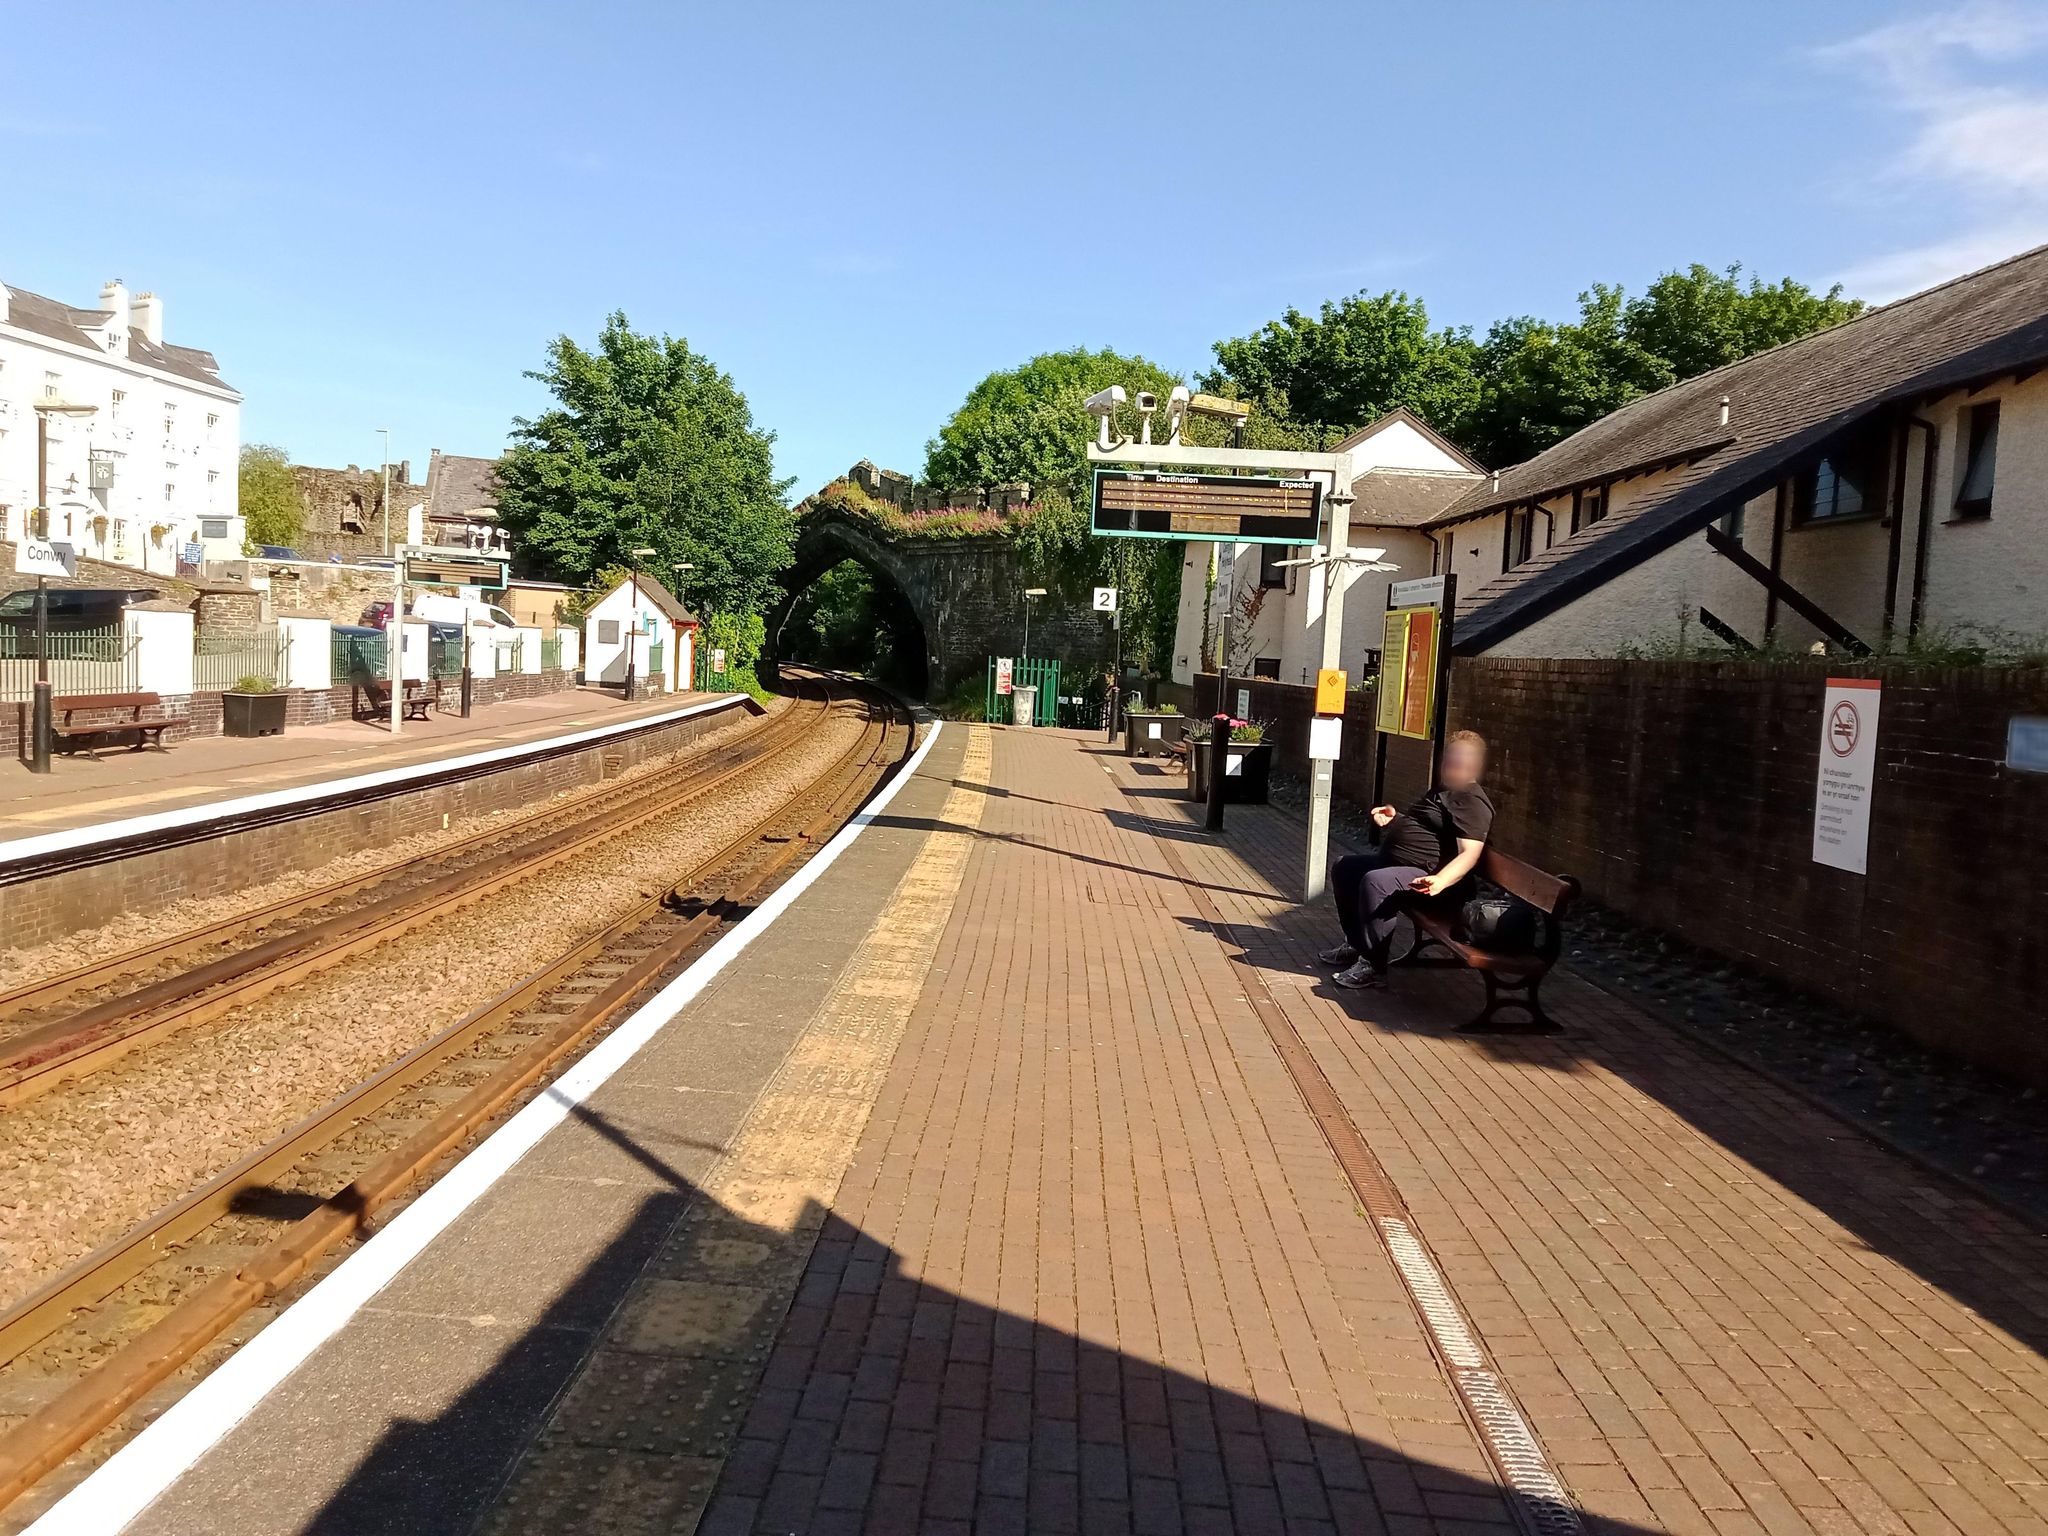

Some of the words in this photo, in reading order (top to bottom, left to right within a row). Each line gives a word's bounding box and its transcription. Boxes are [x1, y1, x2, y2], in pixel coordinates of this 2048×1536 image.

[1126, 473, 1145, 481] Time
[1156, 475, 1199, 484] Destination
[1280, 481, 1314, 489] Expected
[27, 545, 67, 566] Conwy
[1099, 592, 1110, 606] 2
